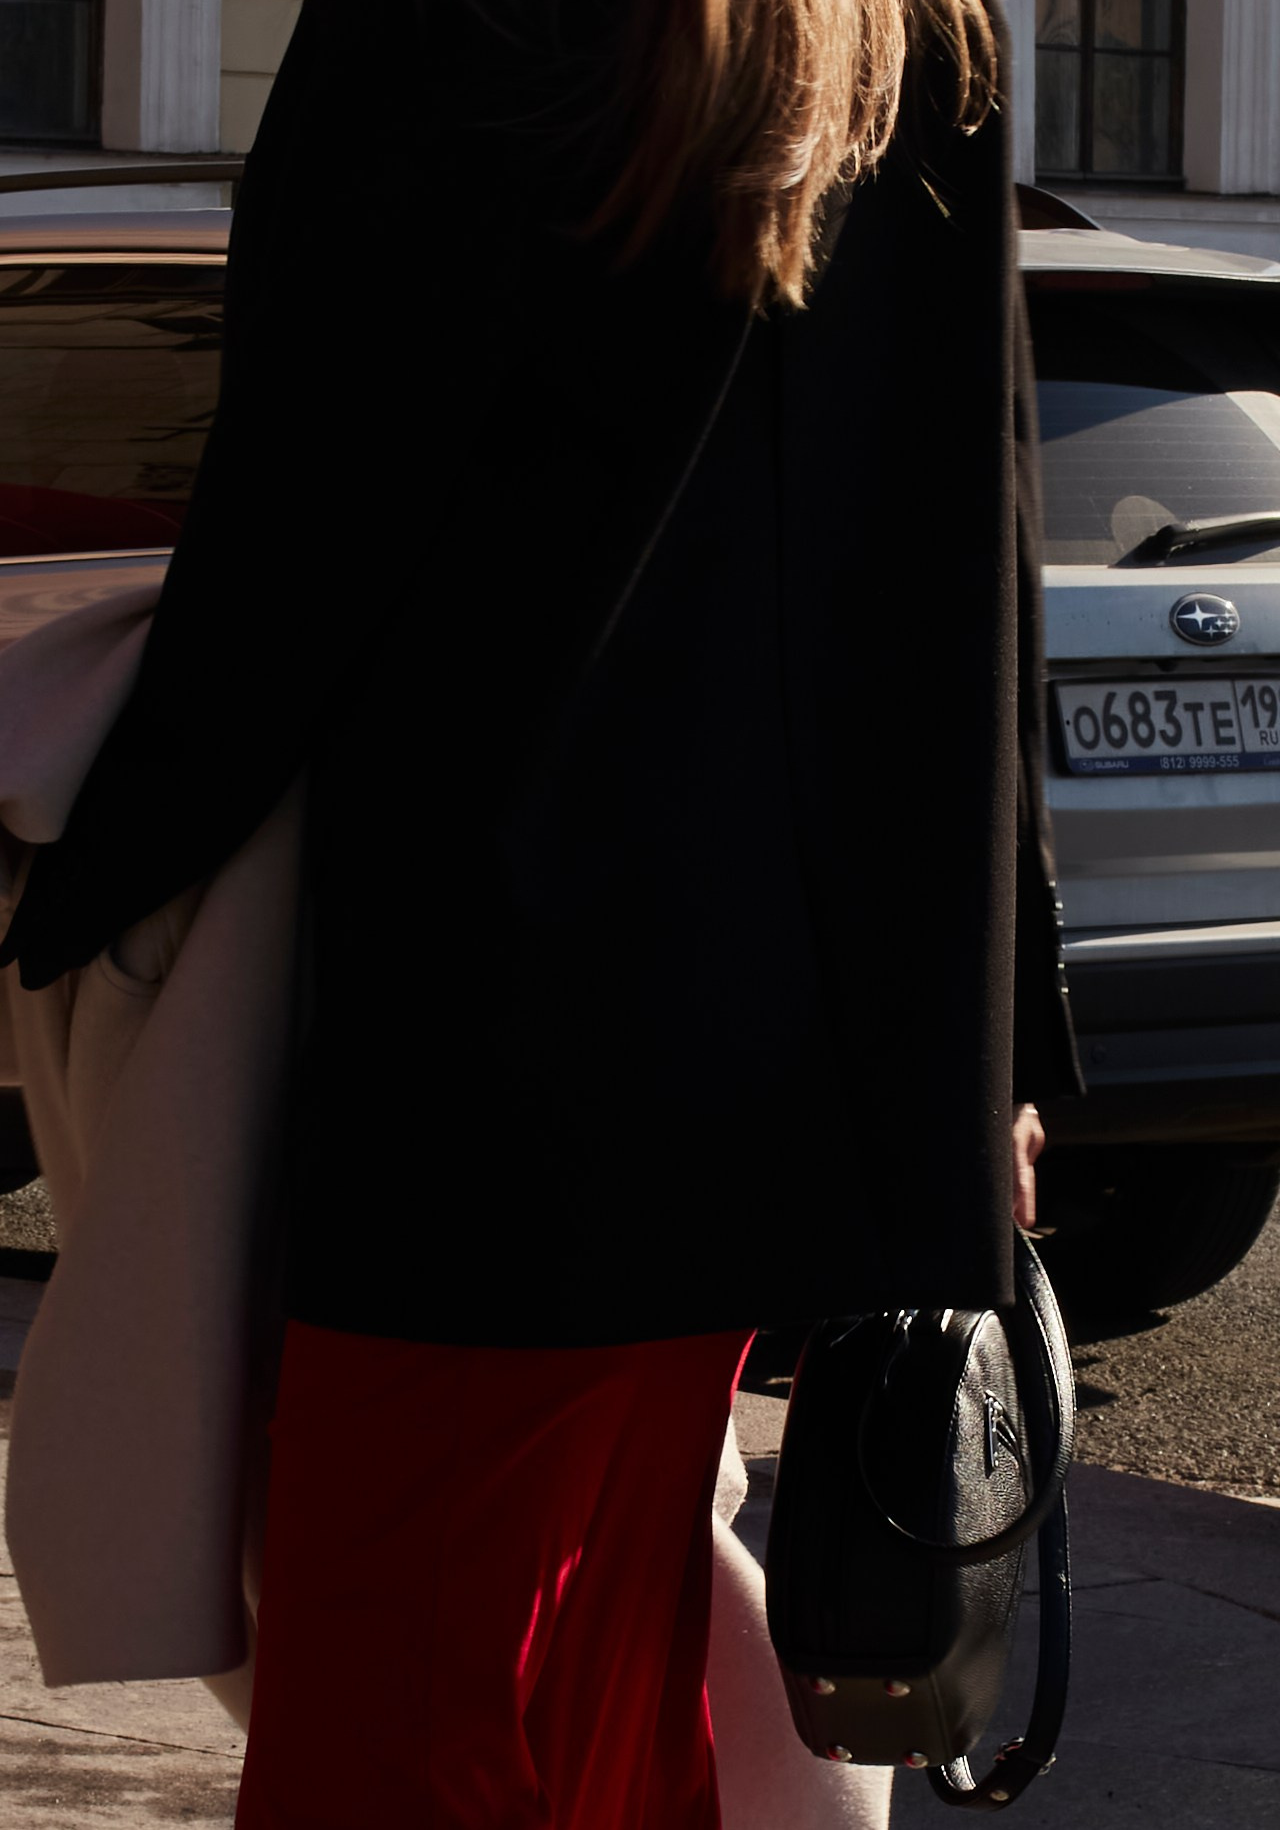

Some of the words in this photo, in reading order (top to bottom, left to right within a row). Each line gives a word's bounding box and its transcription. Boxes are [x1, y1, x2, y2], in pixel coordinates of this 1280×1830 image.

[1241, 685, 1280, 728] 19
[1160, 758, 1185, 770] (812)
[1189, 756, 1240, 769] 9999-555
